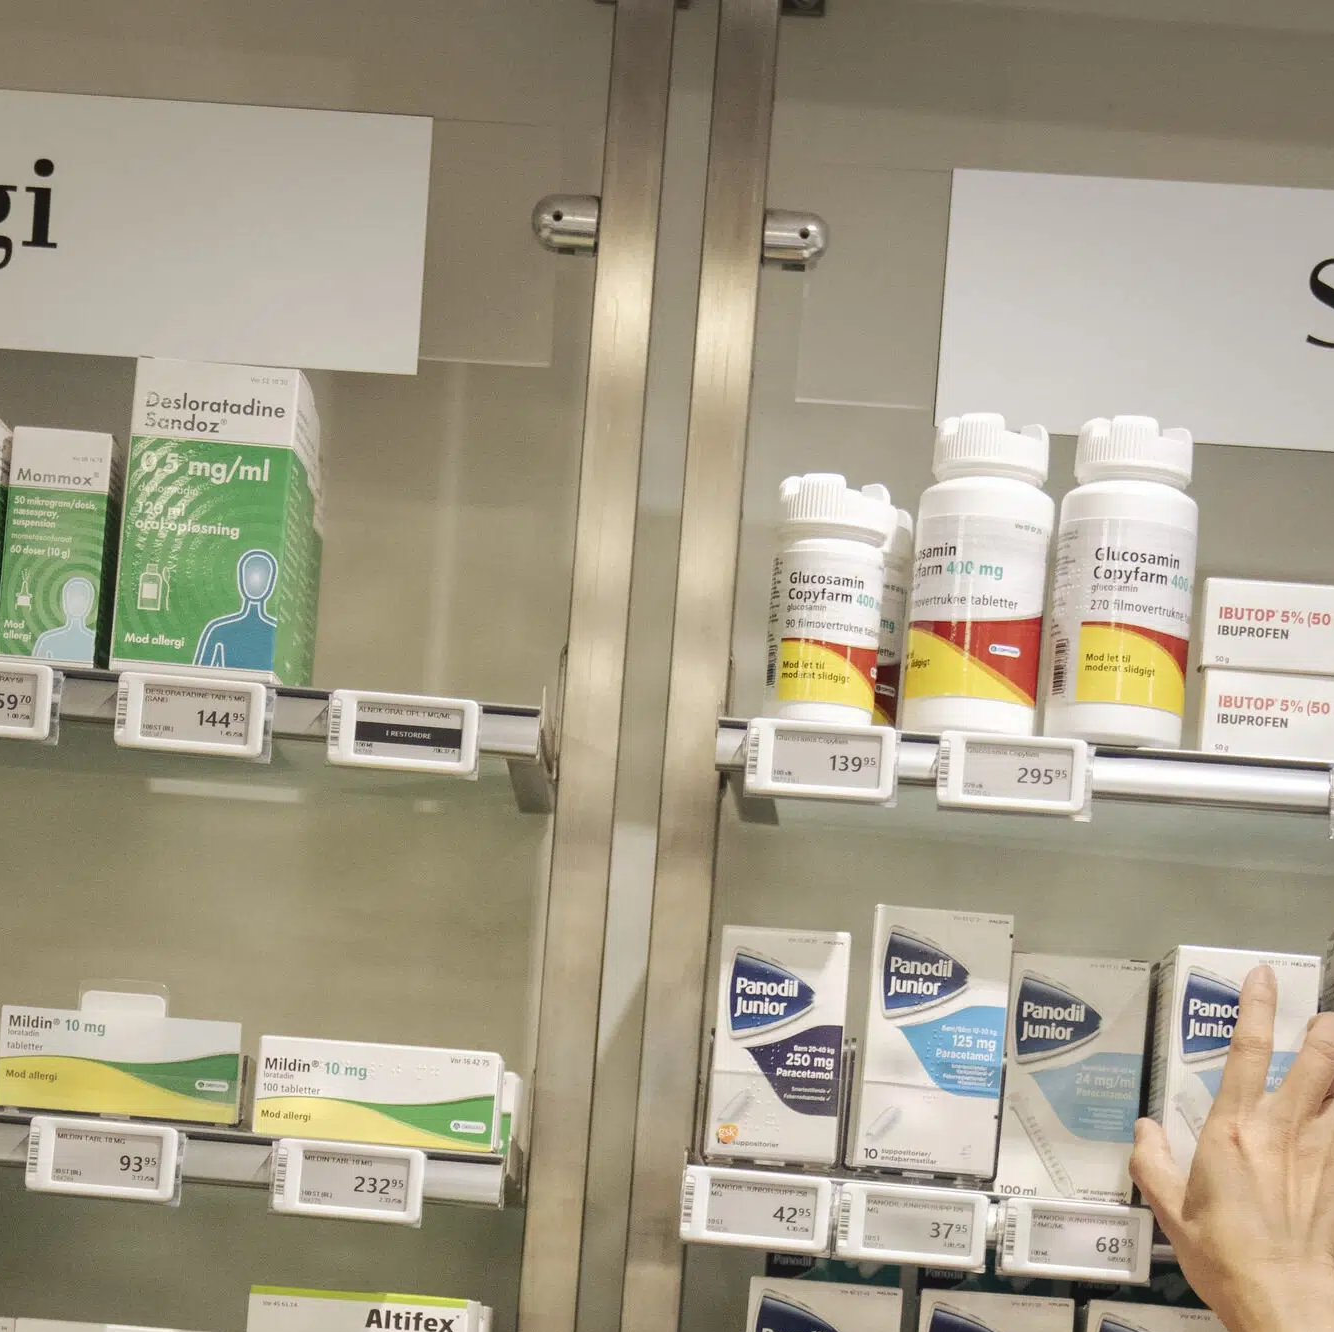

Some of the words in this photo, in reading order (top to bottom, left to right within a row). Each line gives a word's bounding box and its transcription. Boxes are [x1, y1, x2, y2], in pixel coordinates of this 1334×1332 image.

[146, 391, 285, 418] Desloratadine
[189, 456, 269, 483] mg/ml
[1095, 547, 1180, 570] Glucosamin
[790, 571, 865, 589] Glucosamin
[1093, 567, 1168, 586] Copyfarm
[788, 588, 853, 605] Copyfarm
[1219, 606, 1275, 622] IBUTOP
[1281, 609, 1303, 623] 5%
[1307, 610, 1332, 626] (50
[125, 633, 148, 644] Mod
[151, 636, 185, 648] allergi
[1217, 625, 1289, 639] IBUPROFEN
[890, 956, 953, 978] Panodil
[736, 978, 799, 998] Panodil
[888, 977, 940, 997] Junior
[735, 998, 787, 1017] Junior
[786, 1053, 810, 1066] 250
[813, 1055, 833, 1068] mg
[325, 1063, 340, 1075] 10
[344, 1064, 367, 1080] mg
[776, 1068, 833, 1080] Paracetamol
[262, 1082, 279, 1093] 100
[282, 1084, 320, 1096] tabletter
